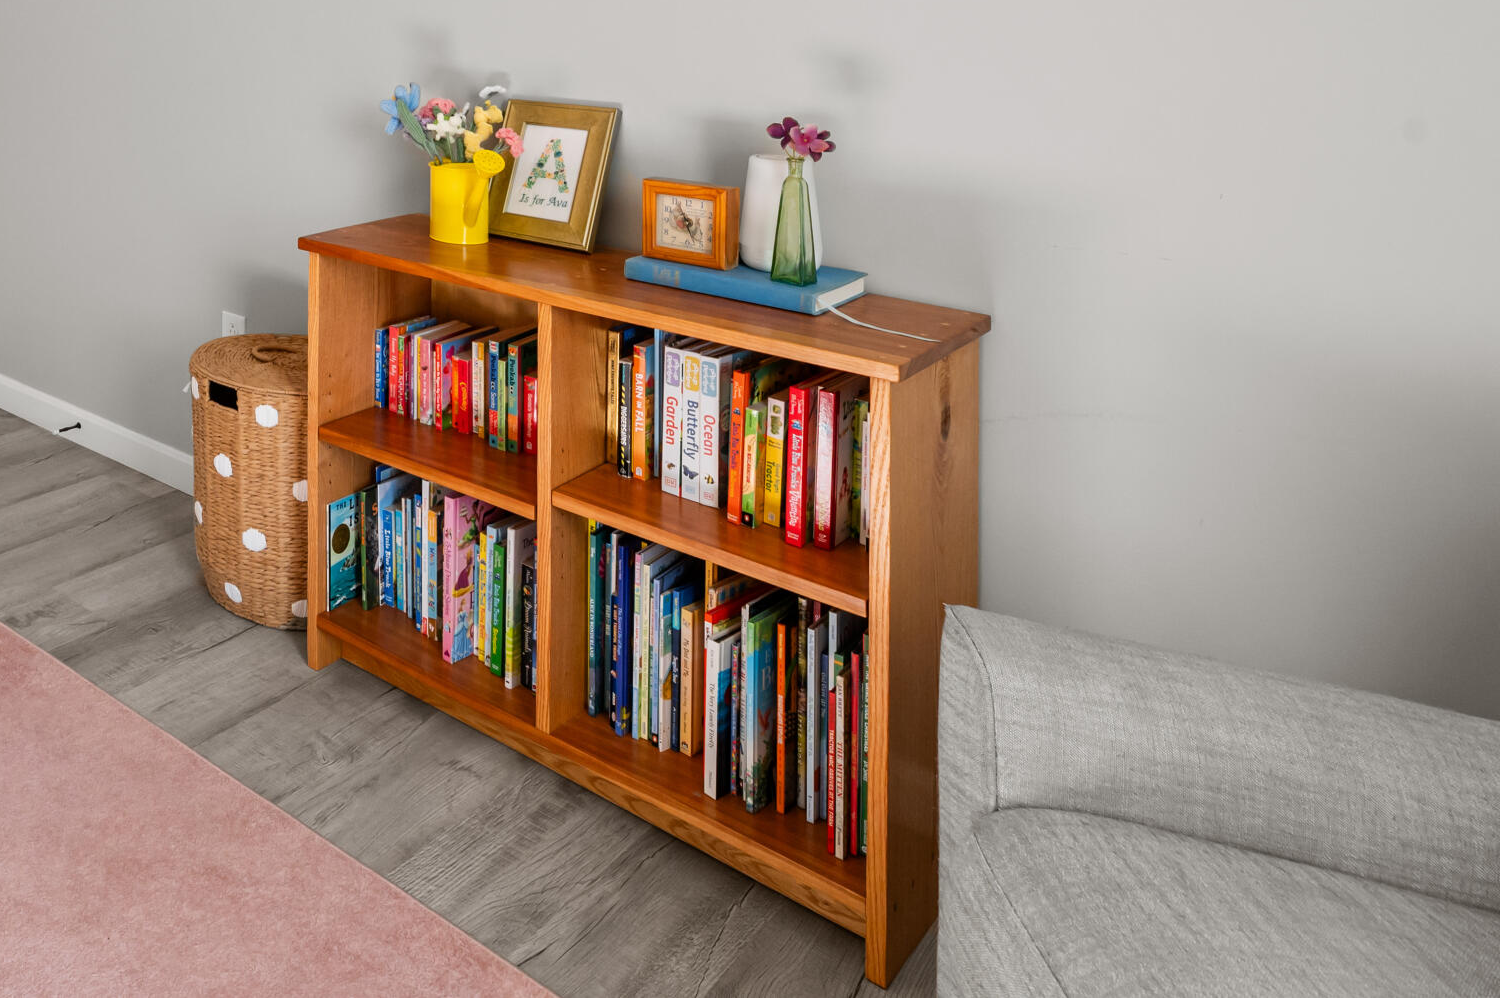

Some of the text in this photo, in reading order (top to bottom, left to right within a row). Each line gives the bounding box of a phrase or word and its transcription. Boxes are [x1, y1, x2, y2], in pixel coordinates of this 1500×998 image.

[523, 138, 569, 194] A
[519, 193, 568, 208] Is for Ava
[635, 409, 643, 433] FALL
[666, 396, 678, 445] Garden
[684, 399, 699, 459] Butterfly
[703, 414, 715, 456] Ocean
[792, 433, 803, 450] Little
[792, 451, 801, 464] Blue
[766, 461, 775, 492] Tractor
[336, 501, 346, 510] THE
[789, 490, 800, 526] Valentine
[524, 599, 533, 653] Dream Animals
[683, 639, 689, 647] My
[683, 669, 689, 677] Me
